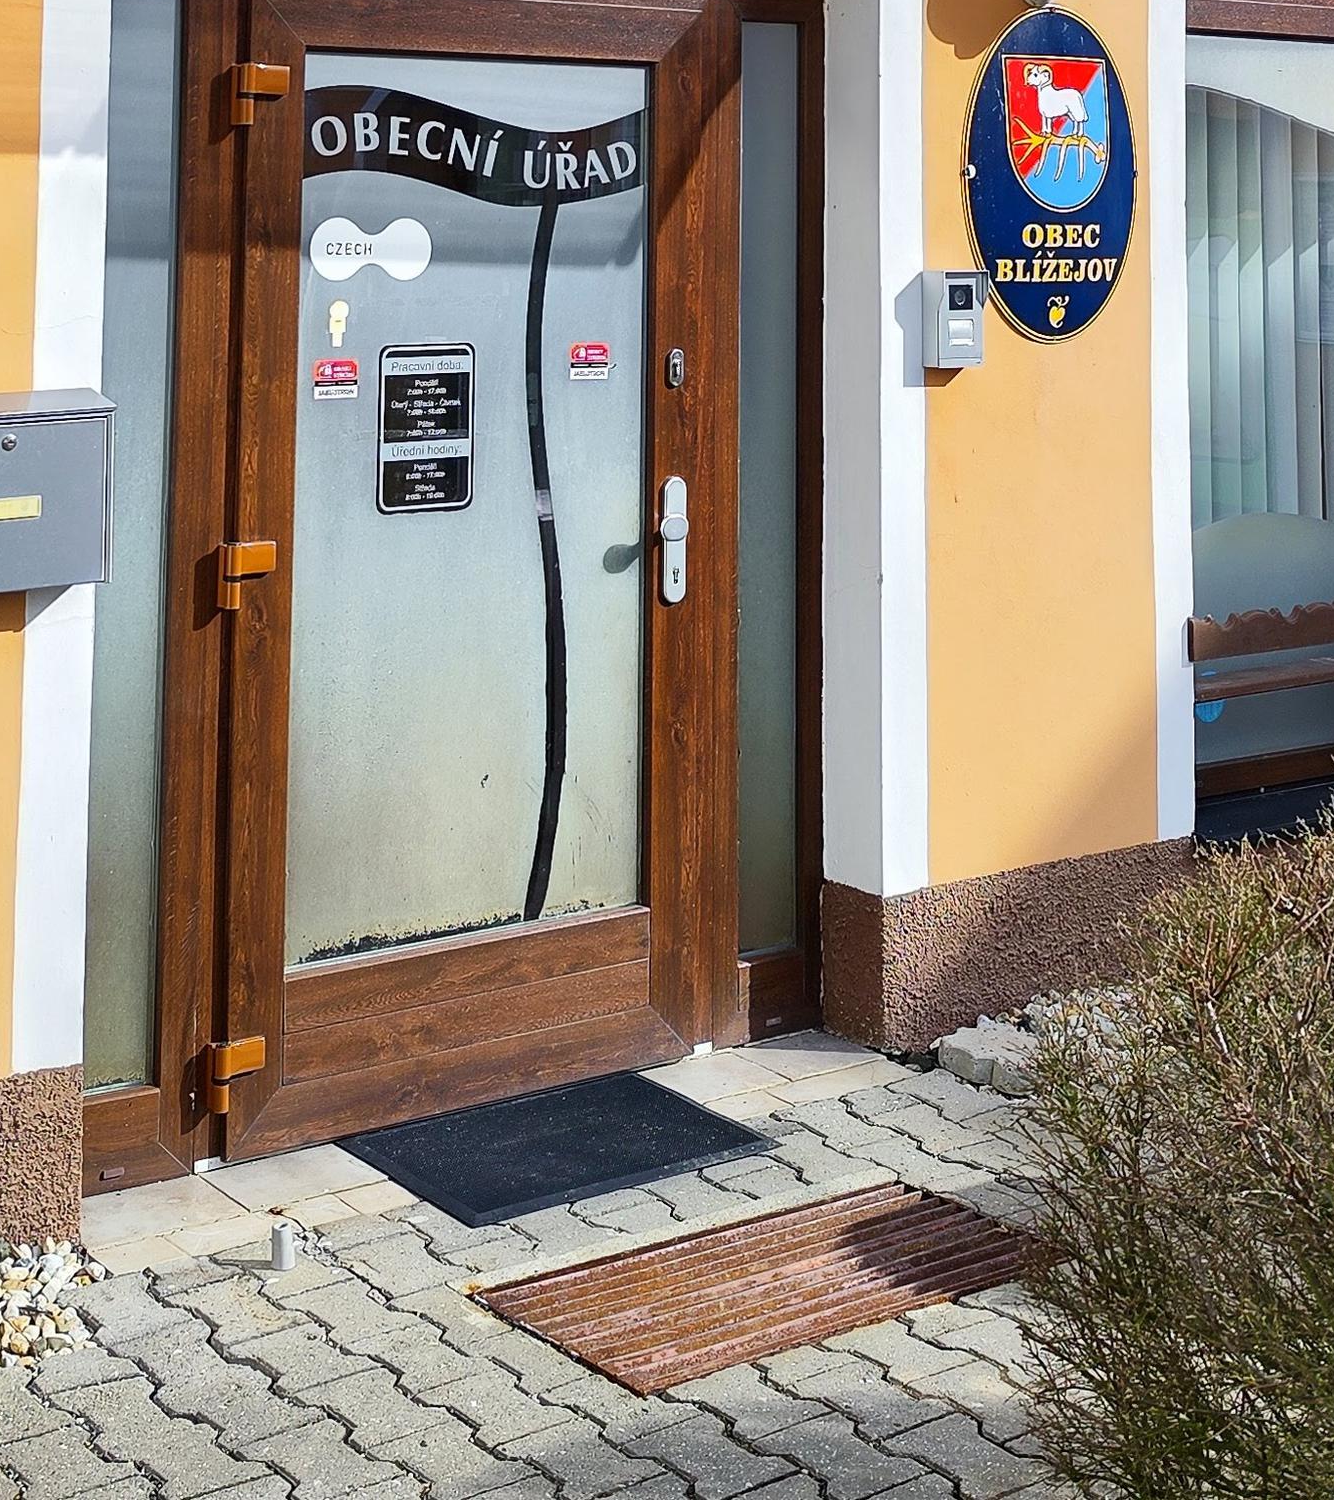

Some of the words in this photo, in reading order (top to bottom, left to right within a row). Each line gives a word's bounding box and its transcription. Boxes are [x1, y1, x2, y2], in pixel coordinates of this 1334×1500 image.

[310, 112, 505, 178] OBECNÍ
[522, 140, 637, 190] ÚŘAD
[325, 242, 373, 256] CZECH
[1021, 223, 1101, 250] OBEC
[994, 251, 1118, 284] BLÍŽEJOV
